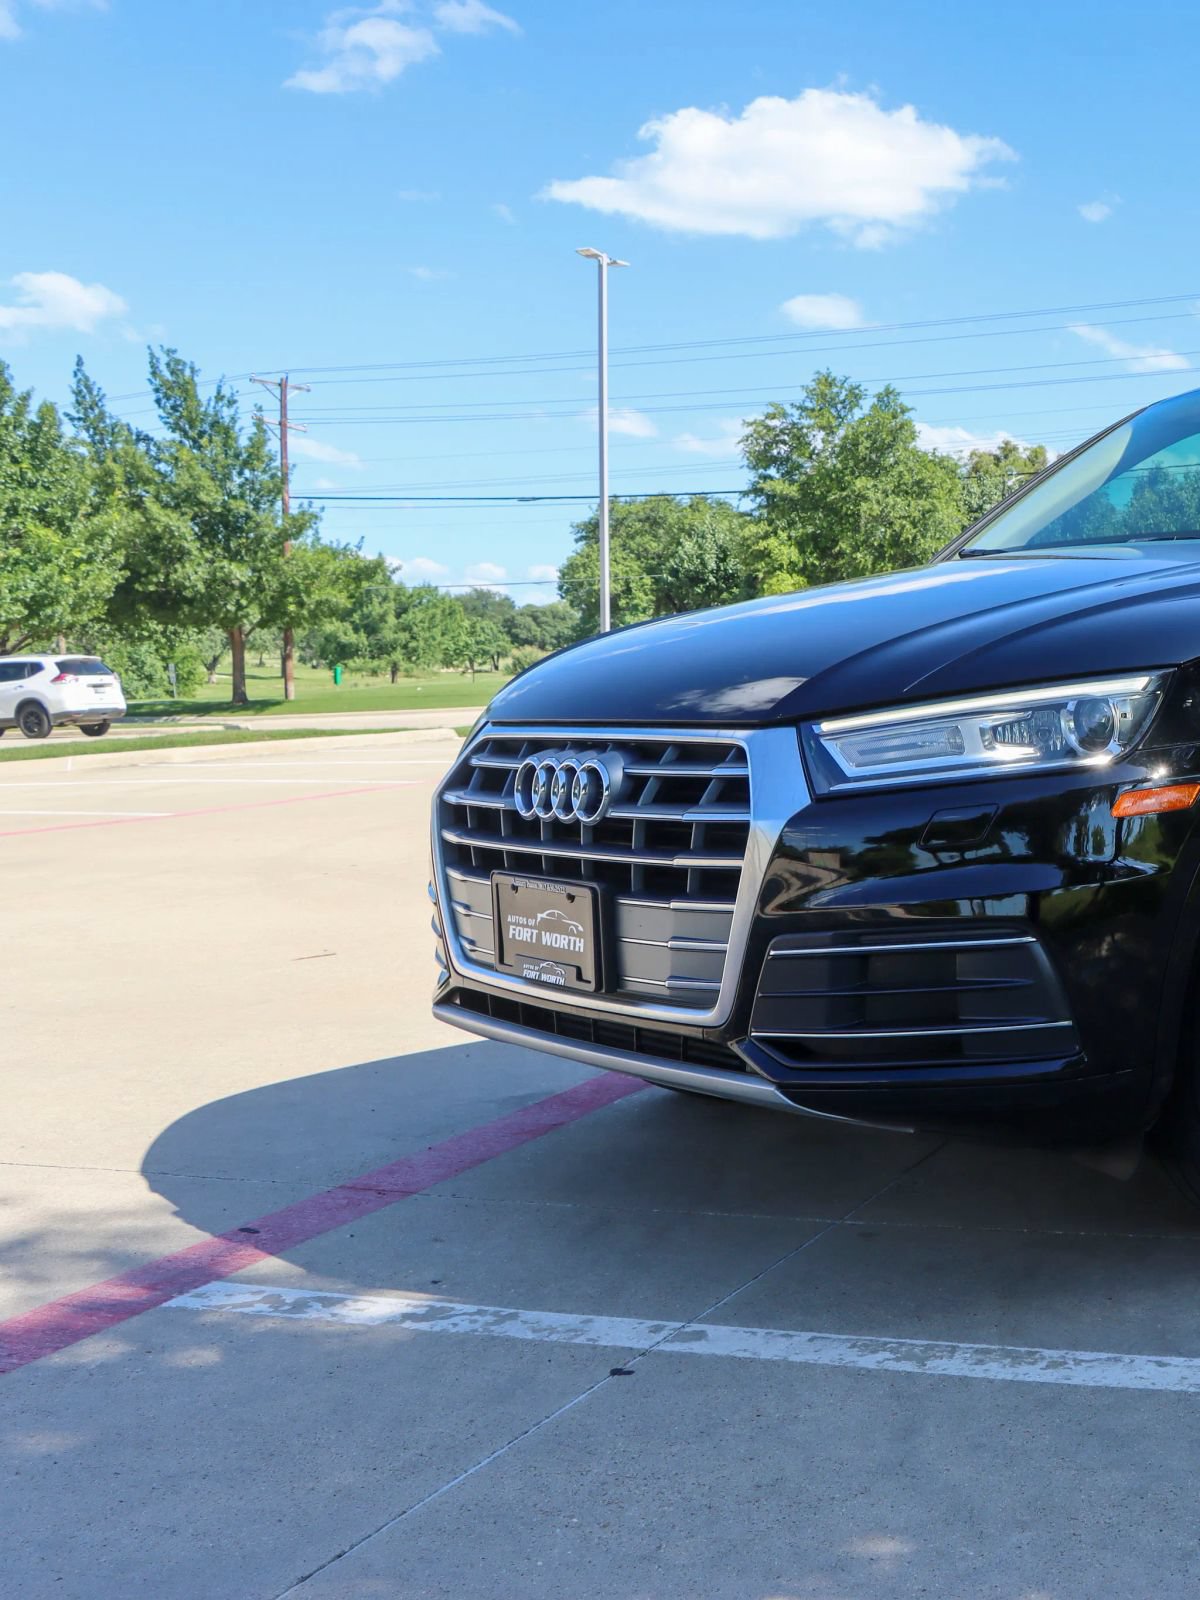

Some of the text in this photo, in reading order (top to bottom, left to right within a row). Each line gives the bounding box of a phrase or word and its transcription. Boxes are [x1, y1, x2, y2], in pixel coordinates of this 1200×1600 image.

[507, 915, 536, 926] AUTOS OF
[509, 925, 584, 952] FORT WORTH
[523, 969, 565, 985] FORT WORTH
